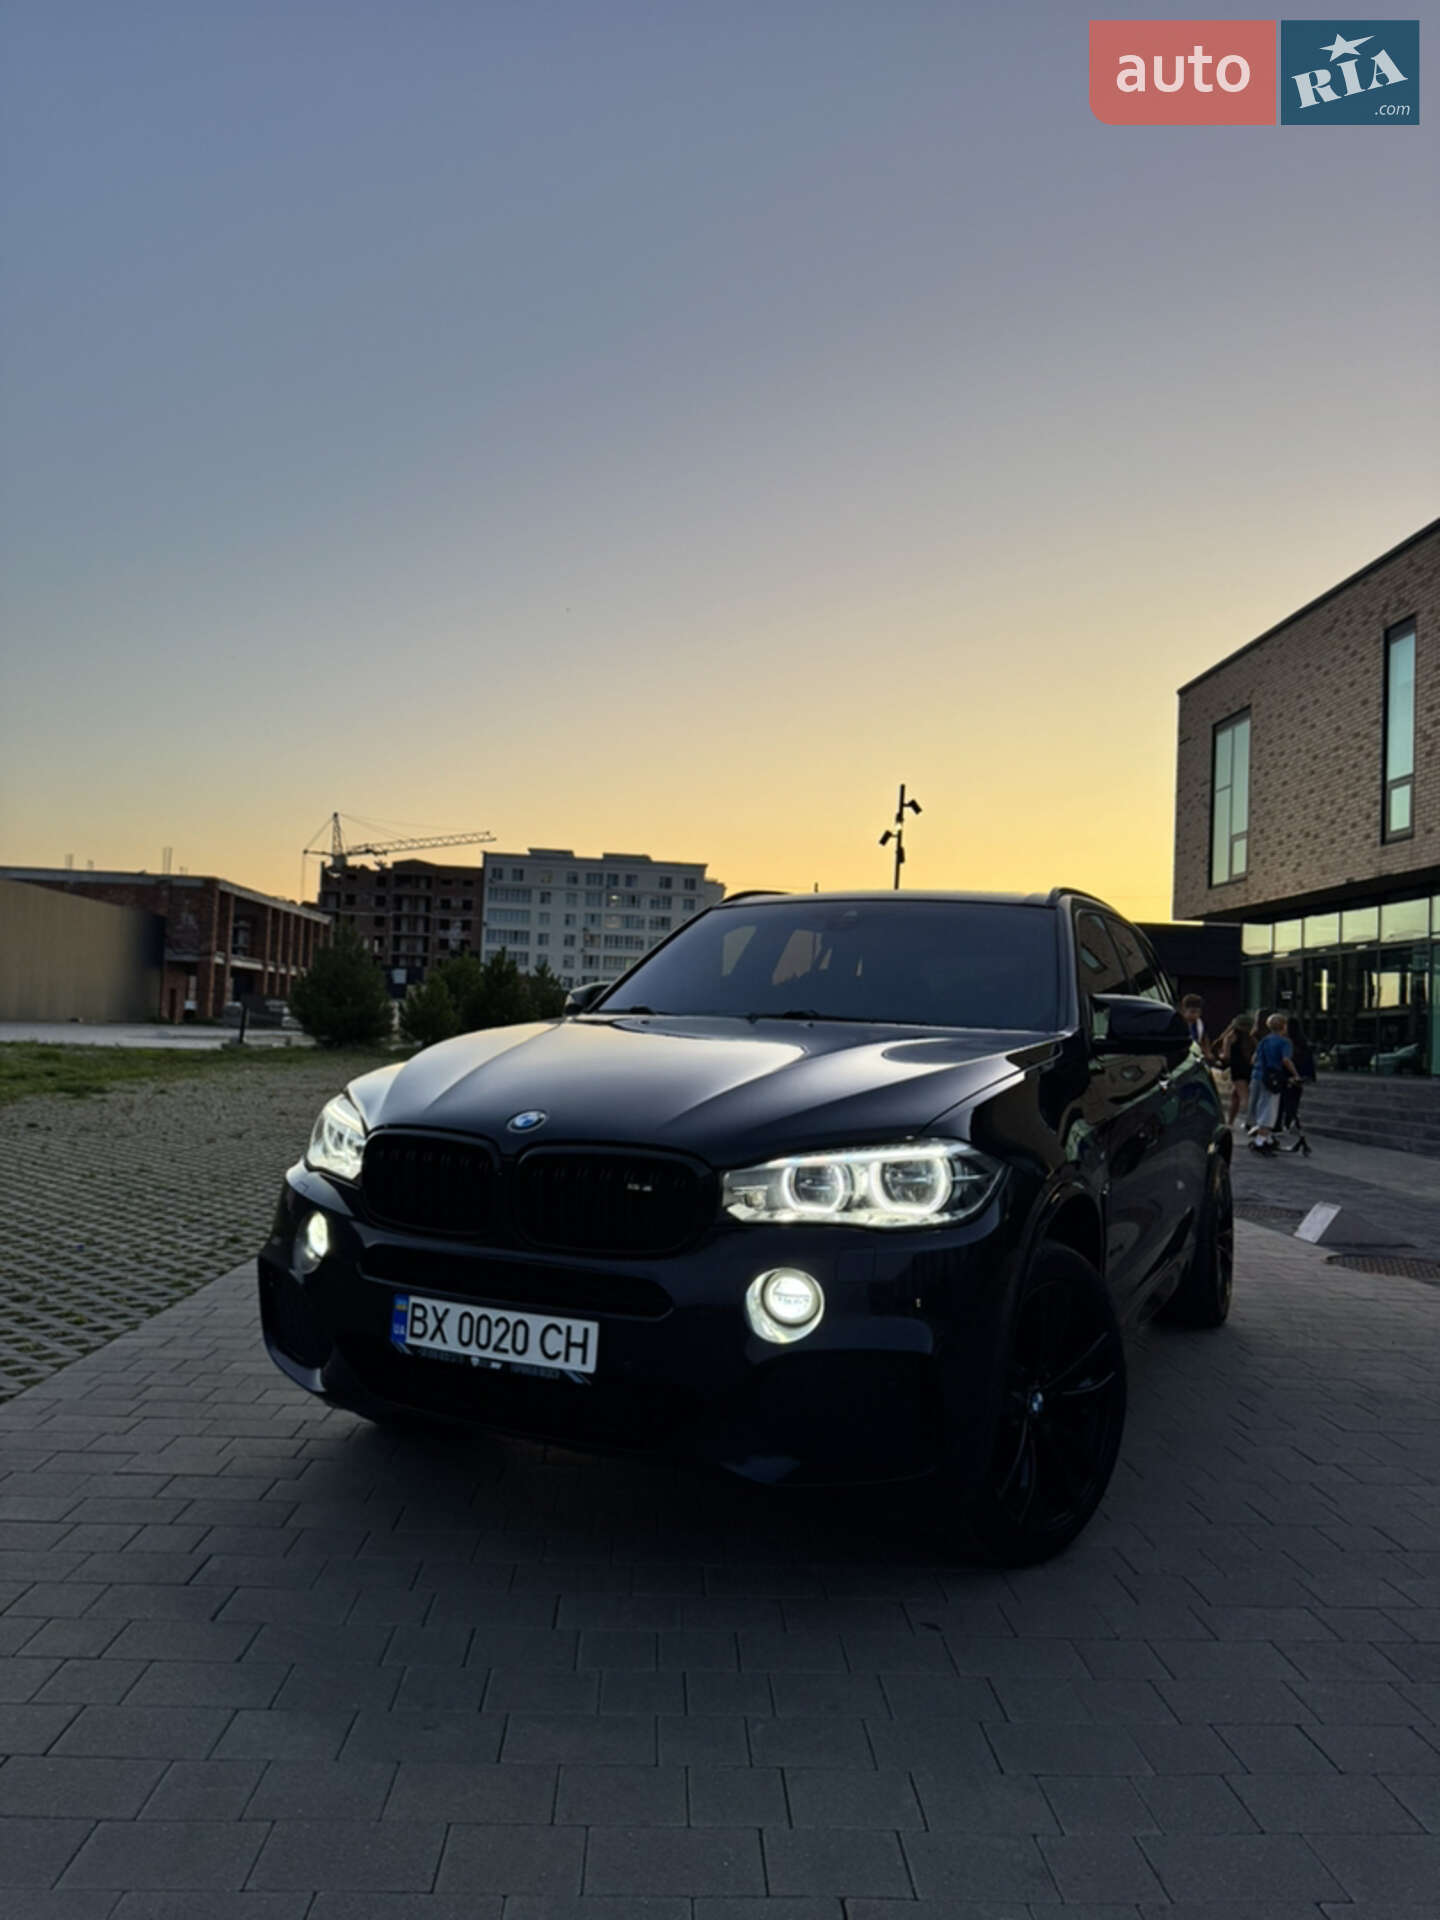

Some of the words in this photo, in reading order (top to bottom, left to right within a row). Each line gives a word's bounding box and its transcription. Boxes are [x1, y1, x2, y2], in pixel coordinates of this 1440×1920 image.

[409, 1302, 450, 1345] BX
[457, 1311, 530, 1356] 0020
[539, 1323, 590, 1366] CH
